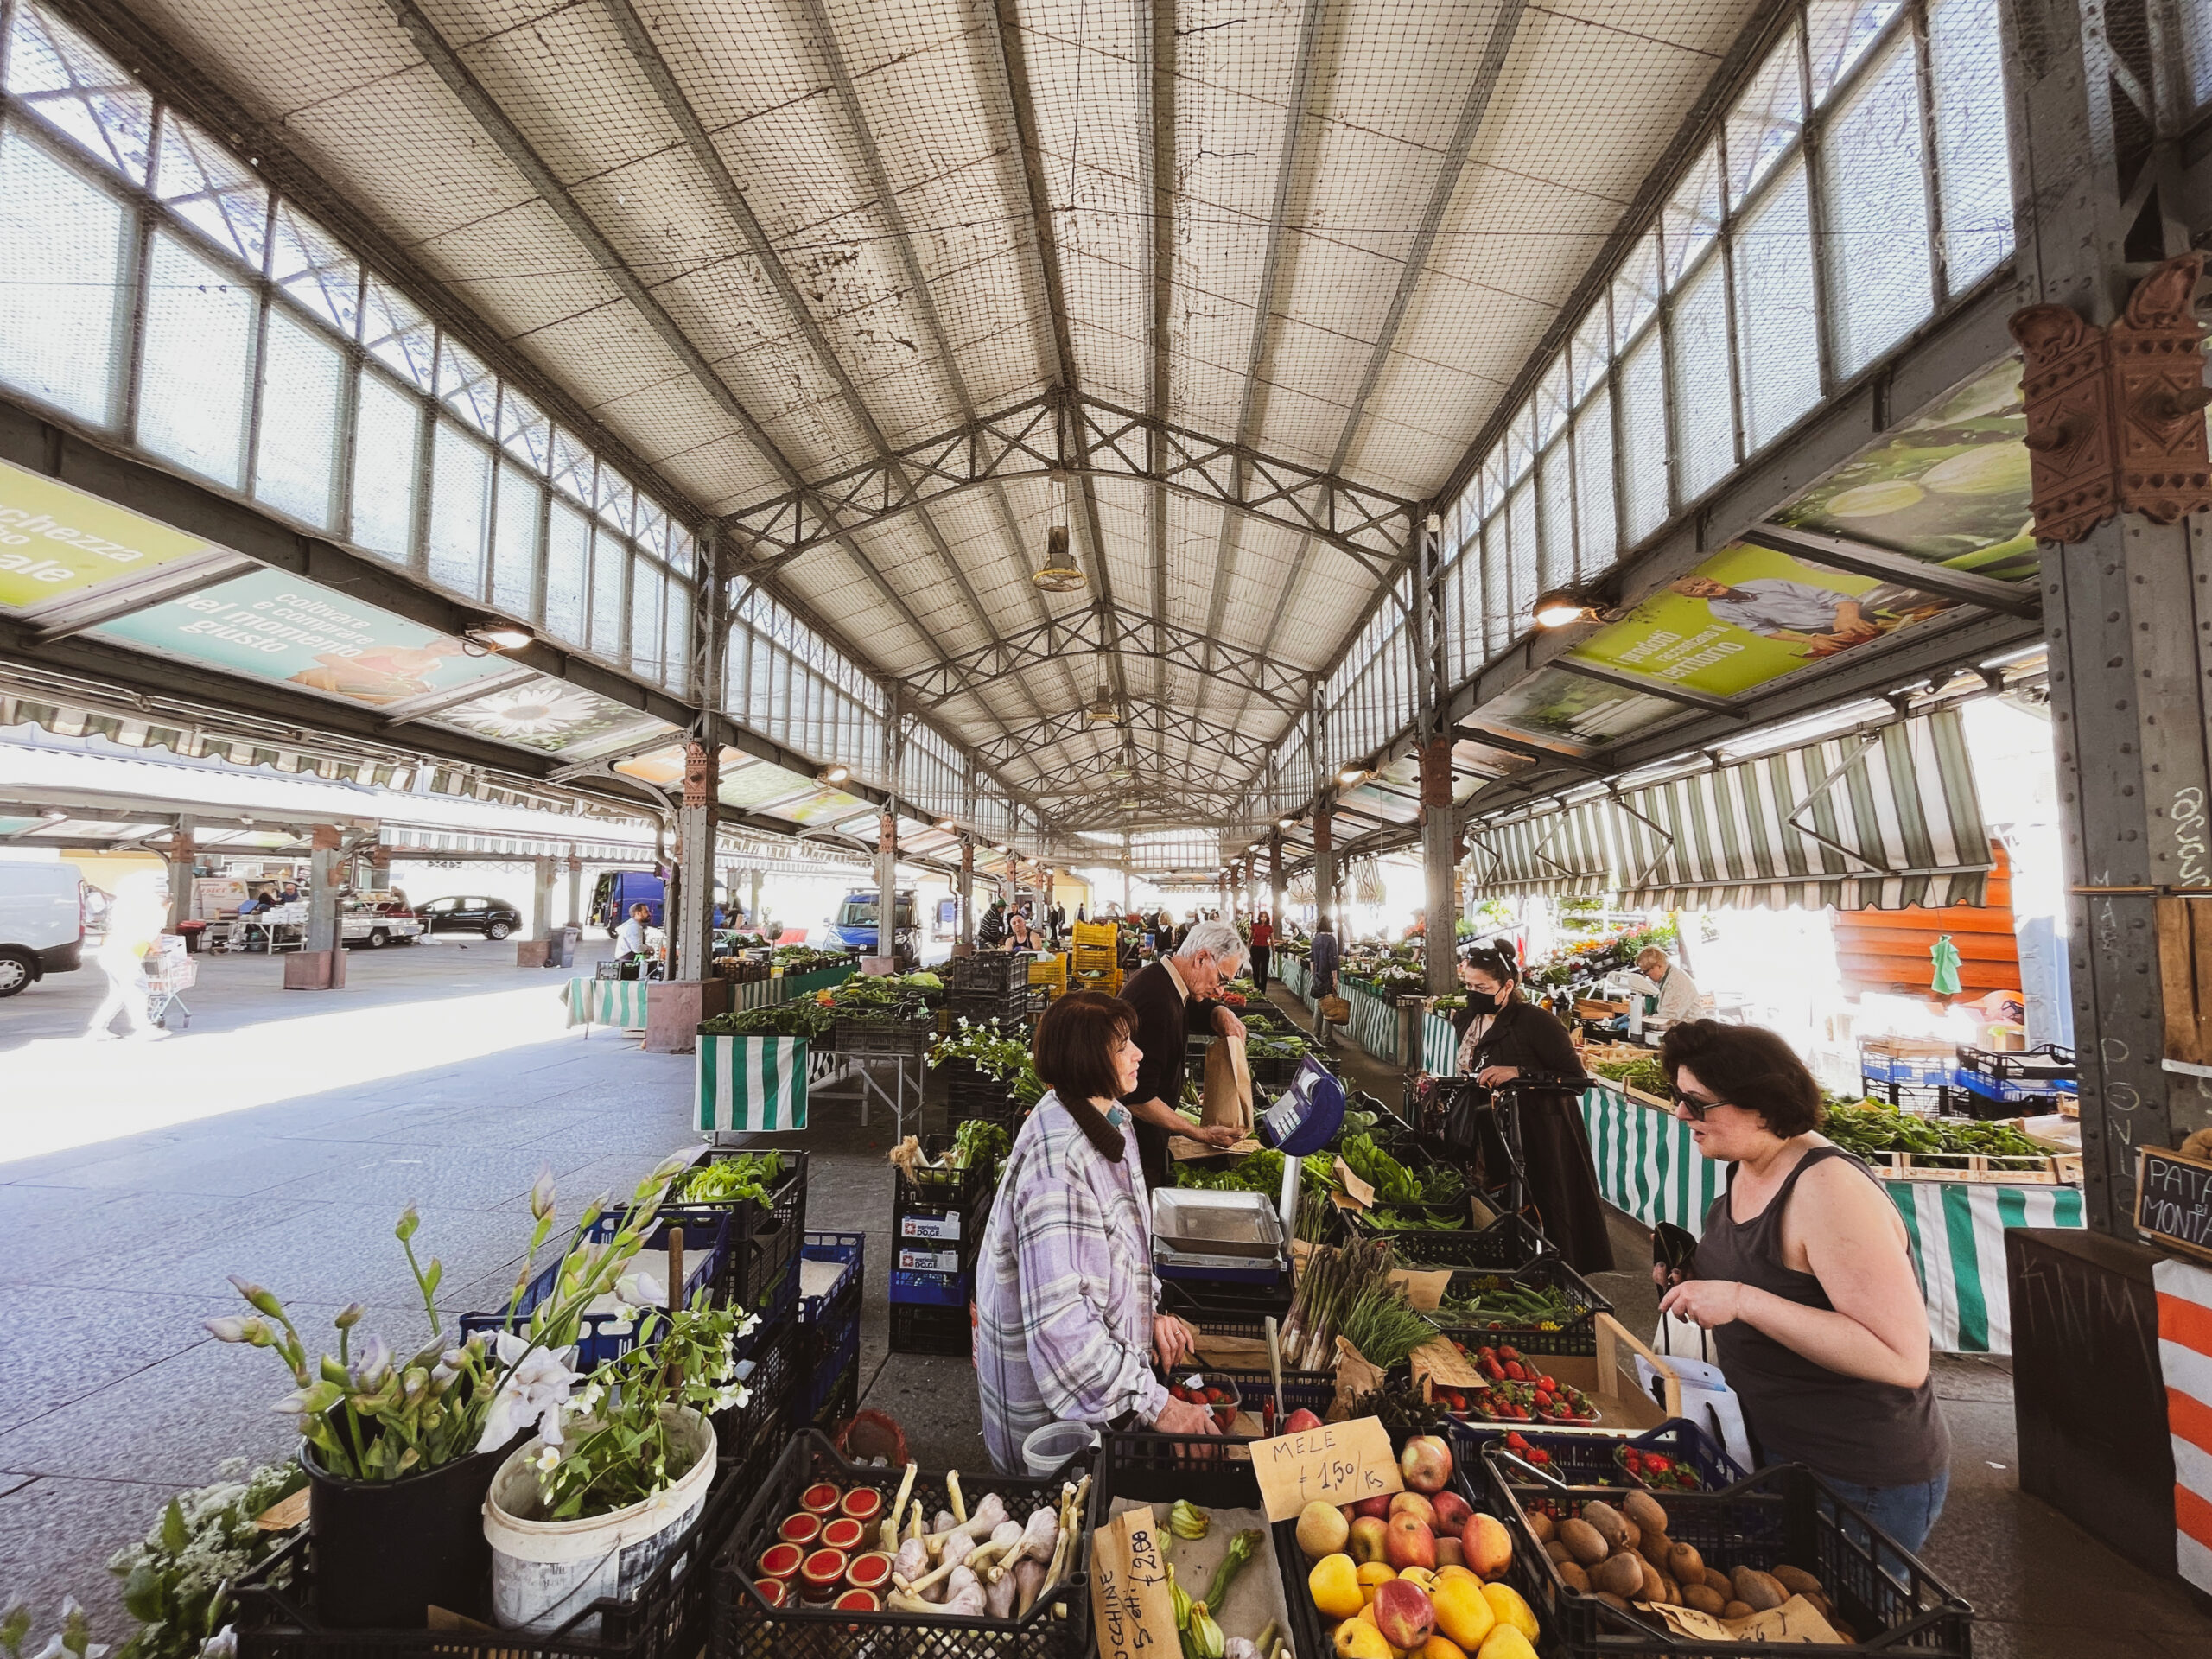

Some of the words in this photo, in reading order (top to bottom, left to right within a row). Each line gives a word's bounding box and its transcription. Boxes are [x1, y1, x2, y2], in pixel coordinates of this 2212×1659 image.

[252, 601, 276, 610] e
[272, 607, 375, 645] comprare
[275, 594, 371, 629] coltivare
[1707, 624, 1731, 633] il
[178, 620, 289, 652] giusto
[222, 611, 364, 658] momento
[1618, 630, 1682, 664] prodotti
[1652, 641, 1745, 680] territorio
[1273, 1430, 1336, 1462] MELE
[1133, 1628, 1154, 1649] 5
